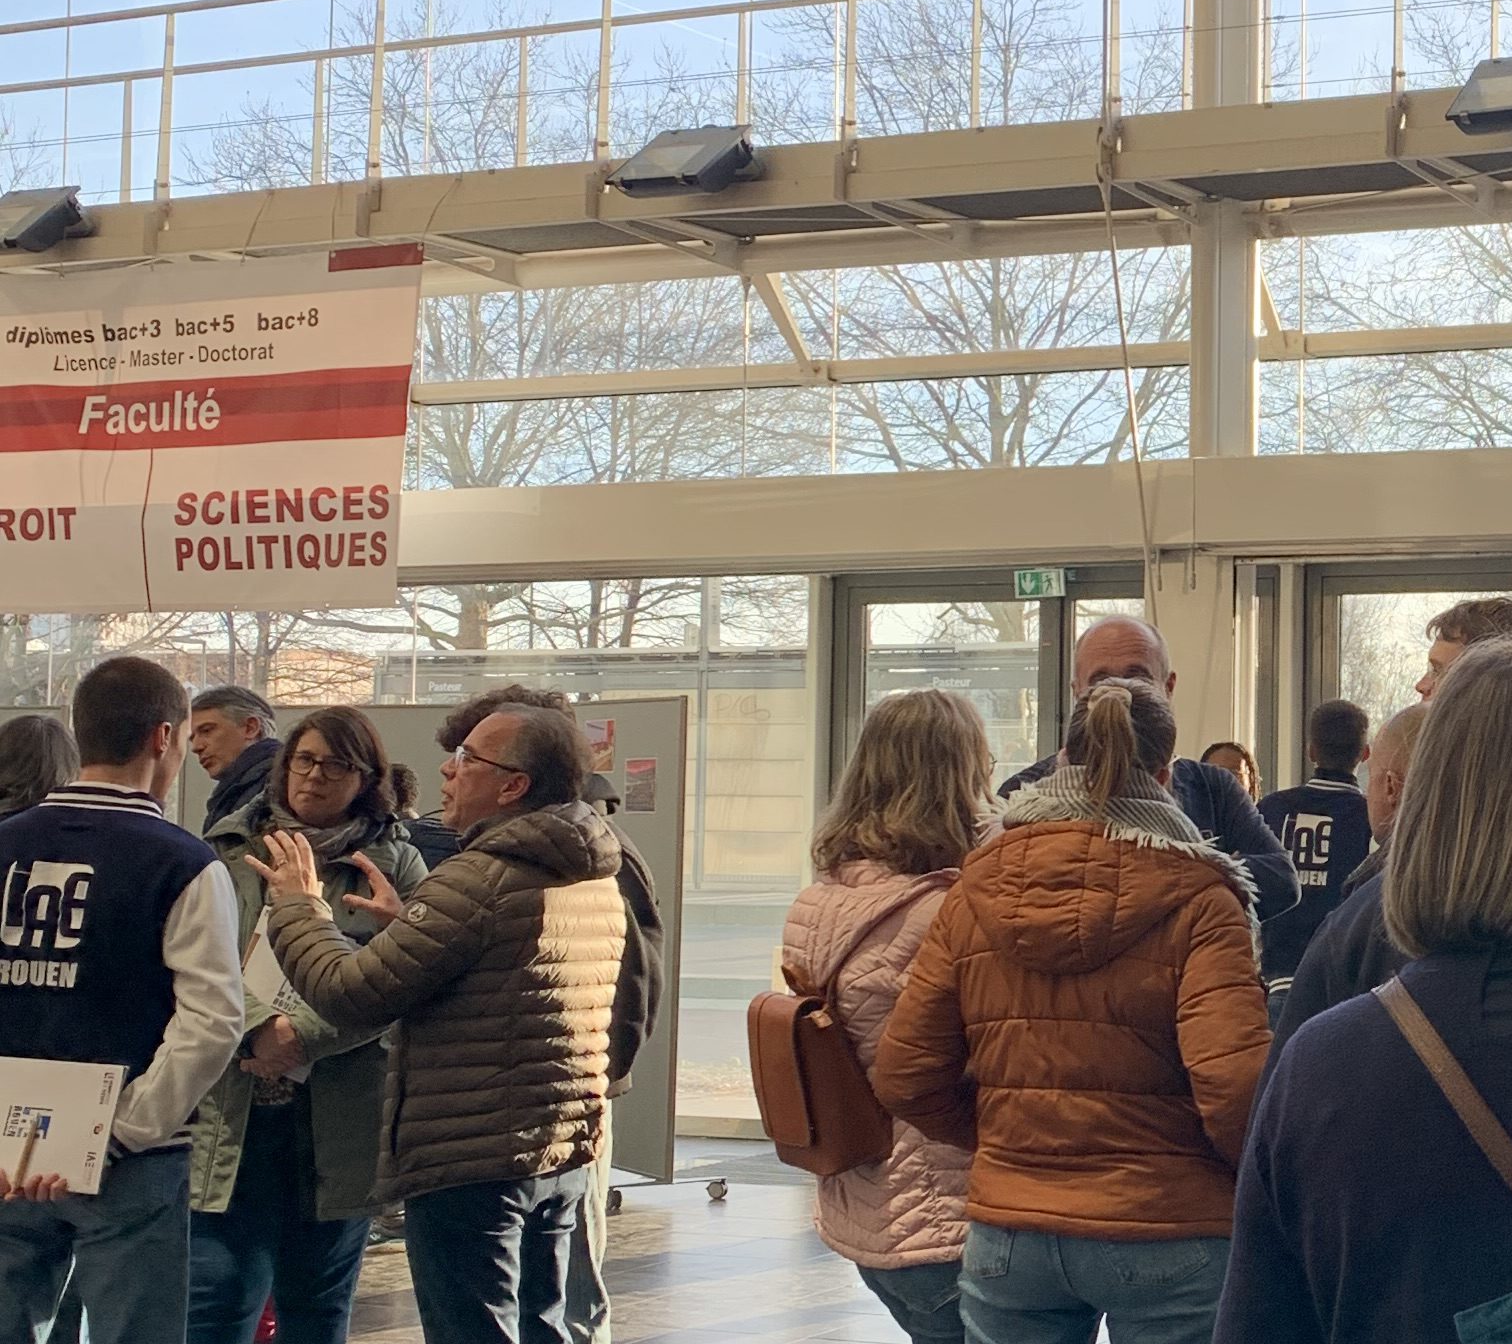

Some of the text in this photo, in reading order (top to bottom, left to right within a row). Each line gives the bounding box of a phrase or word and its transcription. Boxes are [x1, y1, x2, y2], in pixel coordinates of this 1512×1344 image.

[5, 307, 319, 349] diplômes bac+3 bac+5 bac+8
[53, 354, 117, 372] Licence
[129, 348, 185, 368] Master
[198, 342, 274, 363] Doctorat
[78, 387, 221, 435] Faculté
[174, 484, 390, 527] SCIENCES
[174, 531, 388, 571] POLITIQUES
[428, 681, 463, 692] Pasteur
[932, 676, 972, 688] Pasteur
[0, 959, 79, 989] ROUEN
